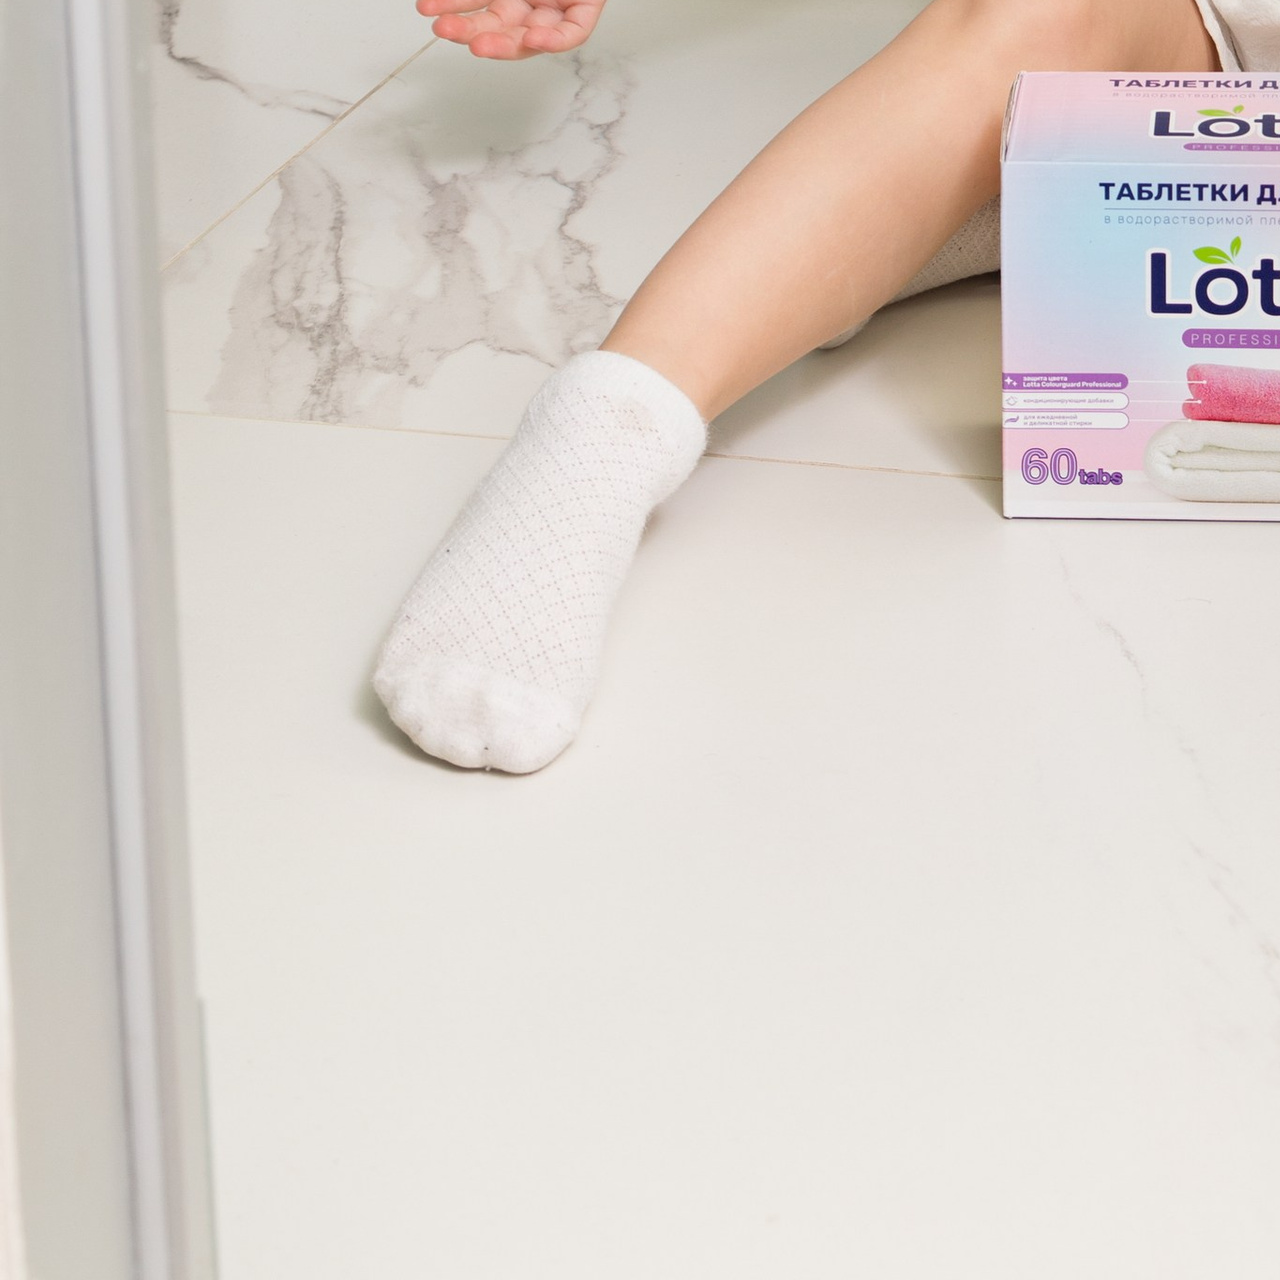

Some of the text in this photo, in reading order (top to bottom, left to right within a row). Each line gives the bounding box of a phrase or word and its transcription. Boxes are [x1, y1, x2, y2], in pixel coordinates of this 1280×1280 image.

[1109, 79, 1253, 89] ТАБЛЕТКИ
[1099, 182, 1249, 202] ТАБЛЕТКИ
[1104, 215, 1111, 224] в
[1117, 214, 1253, 227] водорастворимой
[1041, 381, 1081, 389] Colourguard
[1021, 448, 1123, 485] 60 tabs
